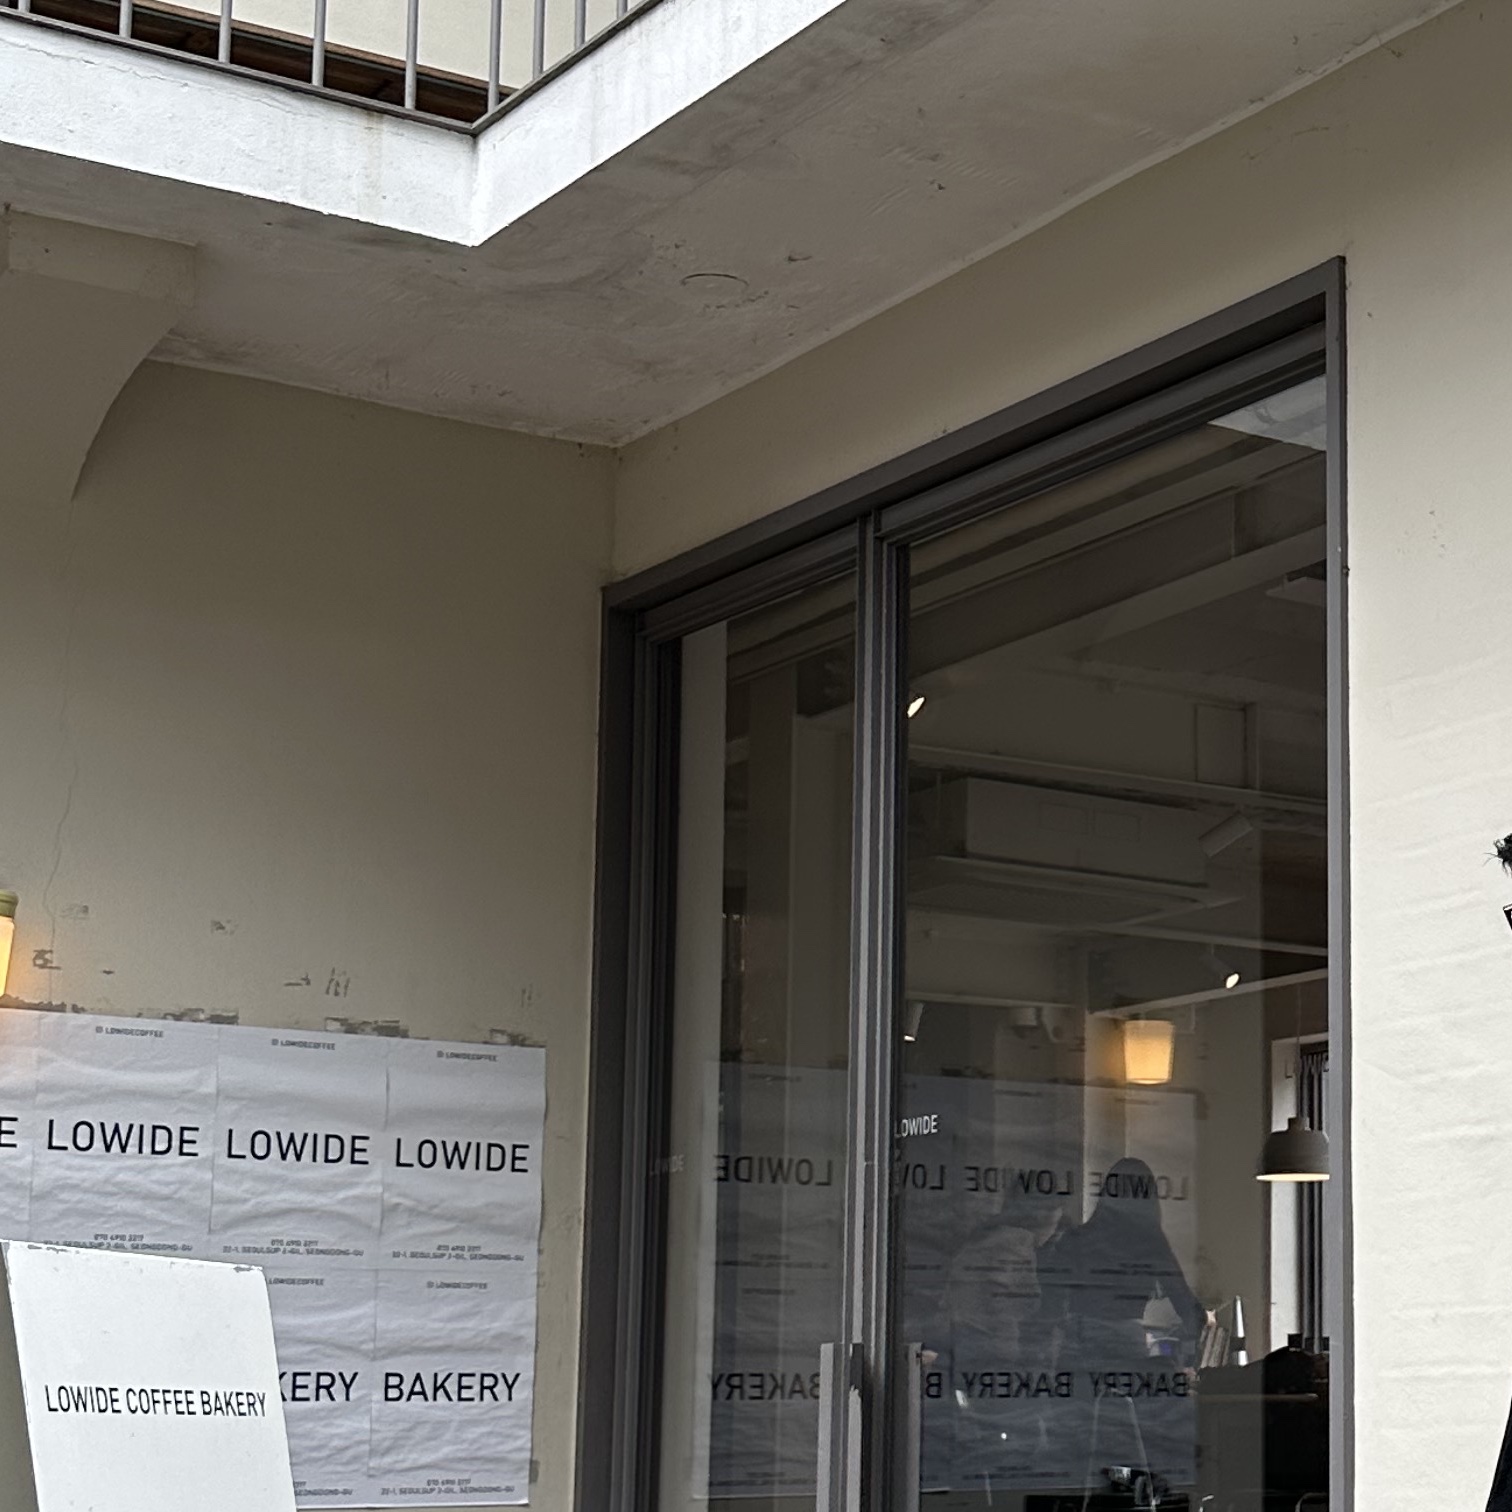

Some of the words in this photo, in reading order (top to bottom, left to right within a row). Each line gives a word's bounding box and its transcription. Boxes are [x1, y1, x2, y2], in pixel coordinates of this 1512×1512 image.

[47, 1119, 200, 1157] LOWIDE
[226, 1128, 370, 1165] LOWIDE
[395, 1138, 530, 1172] LOWIDE
[46, 1385, 121, 1414] LOWIDE
[126, 1388, 197, 1416] COFFEE
[201, 1391, 266, 1417] BAKERY
[383, 1371, 521, 1402] BAKERY
